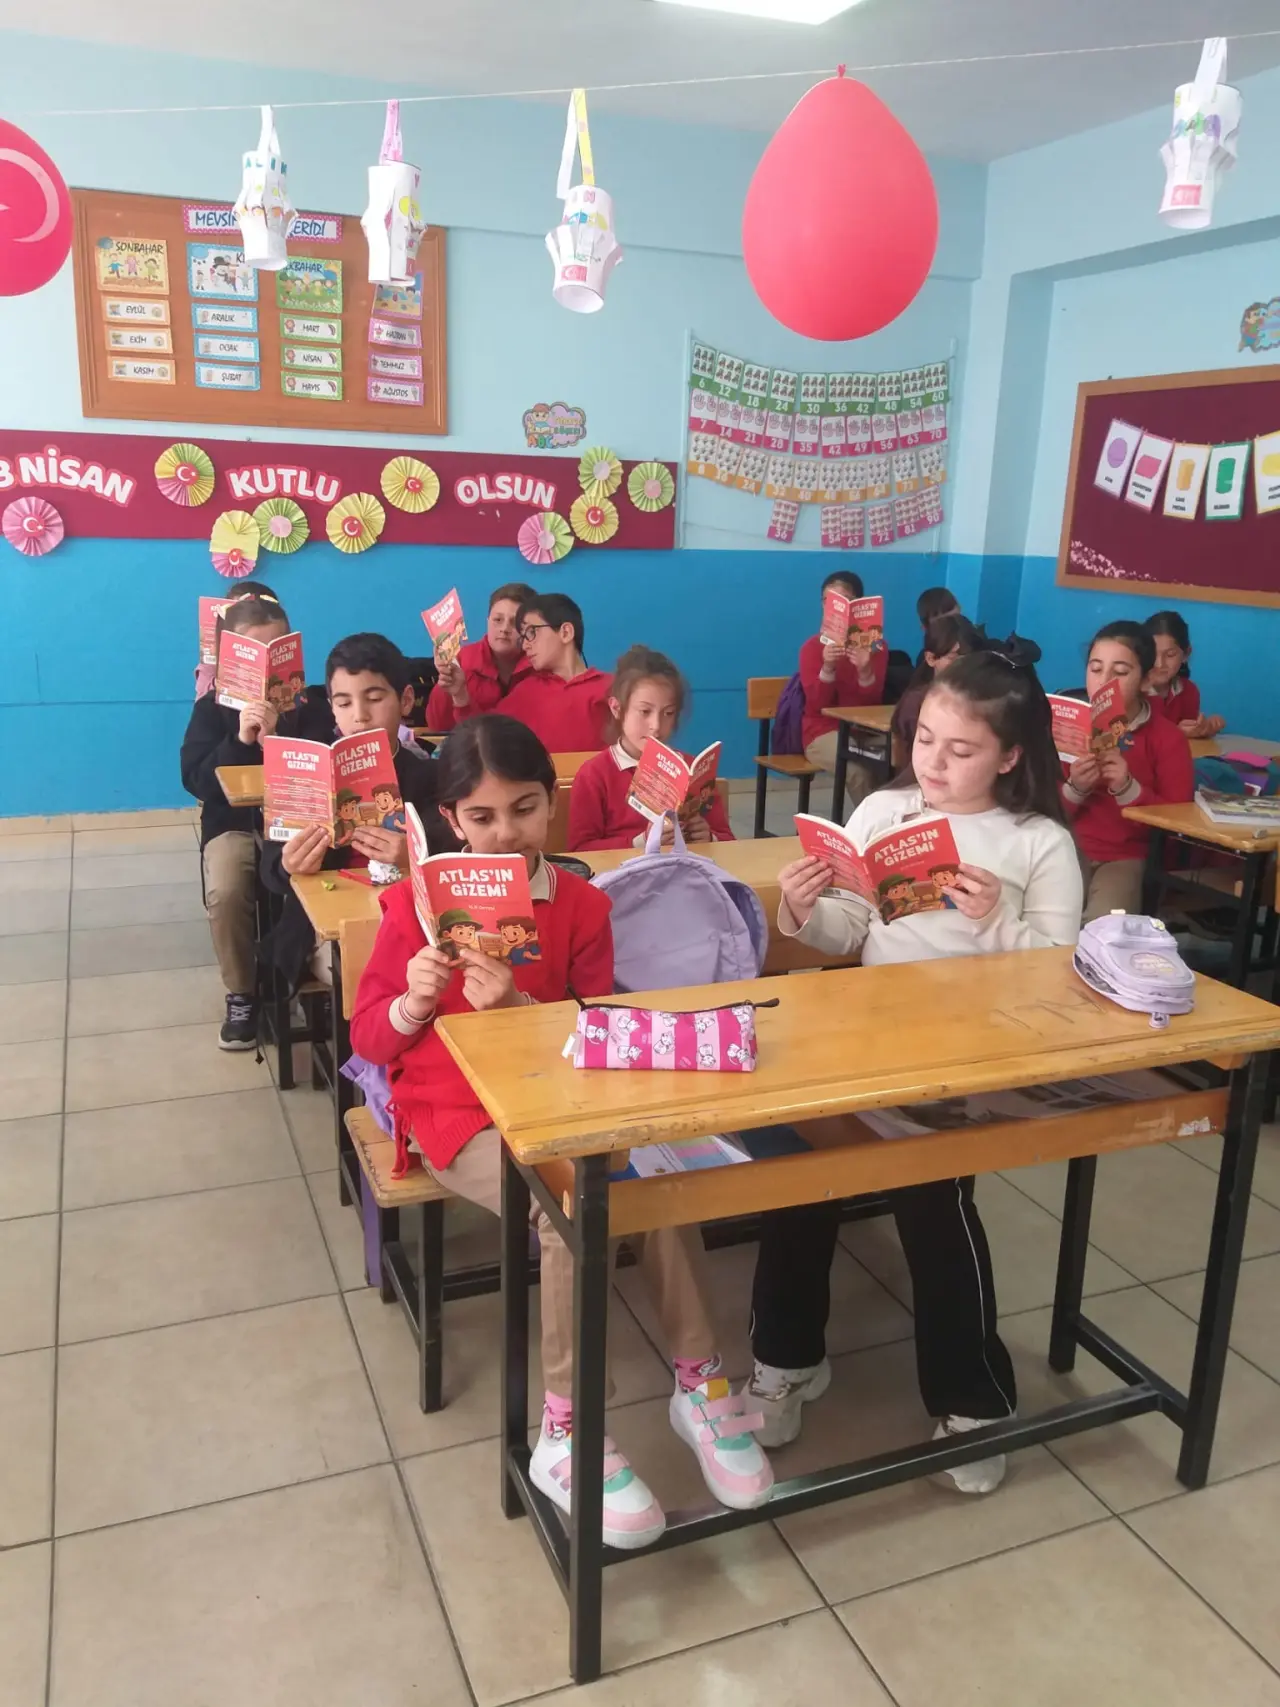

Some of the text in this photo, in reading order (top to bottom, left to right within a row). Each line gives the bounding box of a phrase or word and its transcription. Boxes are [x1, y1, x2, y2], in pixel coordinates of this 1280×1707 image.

[289, 220, 325, 237] ERİDİ
[115, 242, 164, 254] SONBAHAR
[286, 260, 323, 274] KBAHAR
[126, 305, 146, 315] EYLÜL
[211, 313, 235, 322] ARALIK
[303, 323, 320, 333] MART
[129, 335, 147, 344] EKİM
[219, 343, 238, 352] OCAK
[303, 354, 323, 363] NİSAN
[133, 366, 155, 375] KASIM
[221, 372, 242, 382] ŞUBAT
[302, 383, 321, 392] MAYIS
[698, 379, 945, 414] 6 12 18 24 30 36 42 48 54 60
[719, 426, 733, 437] 14
[744, 432, 756, 443] 21
[770, 438, 784, 449] 28
[799, 442, 813, 453] 35
[828, 445, 842, 455] 42
[854, 442, 867, 452] 49
[880, 440, 893, 450] 56
[907, 434, 920, 445] 63
[930, 429, 942, 440] 70
[19, 448, 134, 504] NİSAN
[229, 467, 340, 502] KUTLU
[457, 475, 555, 508] OLSUN
[774, 529, 788, 540] 36
[847, 536, 859, 547] 63
[877, 531, 890, 543] 72
[904, 523, 916, 535] 81
[926, 513, 940, 525] 90
[282, 750, 320, 763] ATLAS'IN
[336, 741, 381, 766] ATLAS'IN
[340, 755, 377, 776] GİZEMİ
[874, 828, 940, 862] ATLAS'IN
[883, 841, 935, 866] GİZEMİ
[438, 868, 514, 884] ATLAS'IN
[450, 883, 508, 897] GİZEMİ
